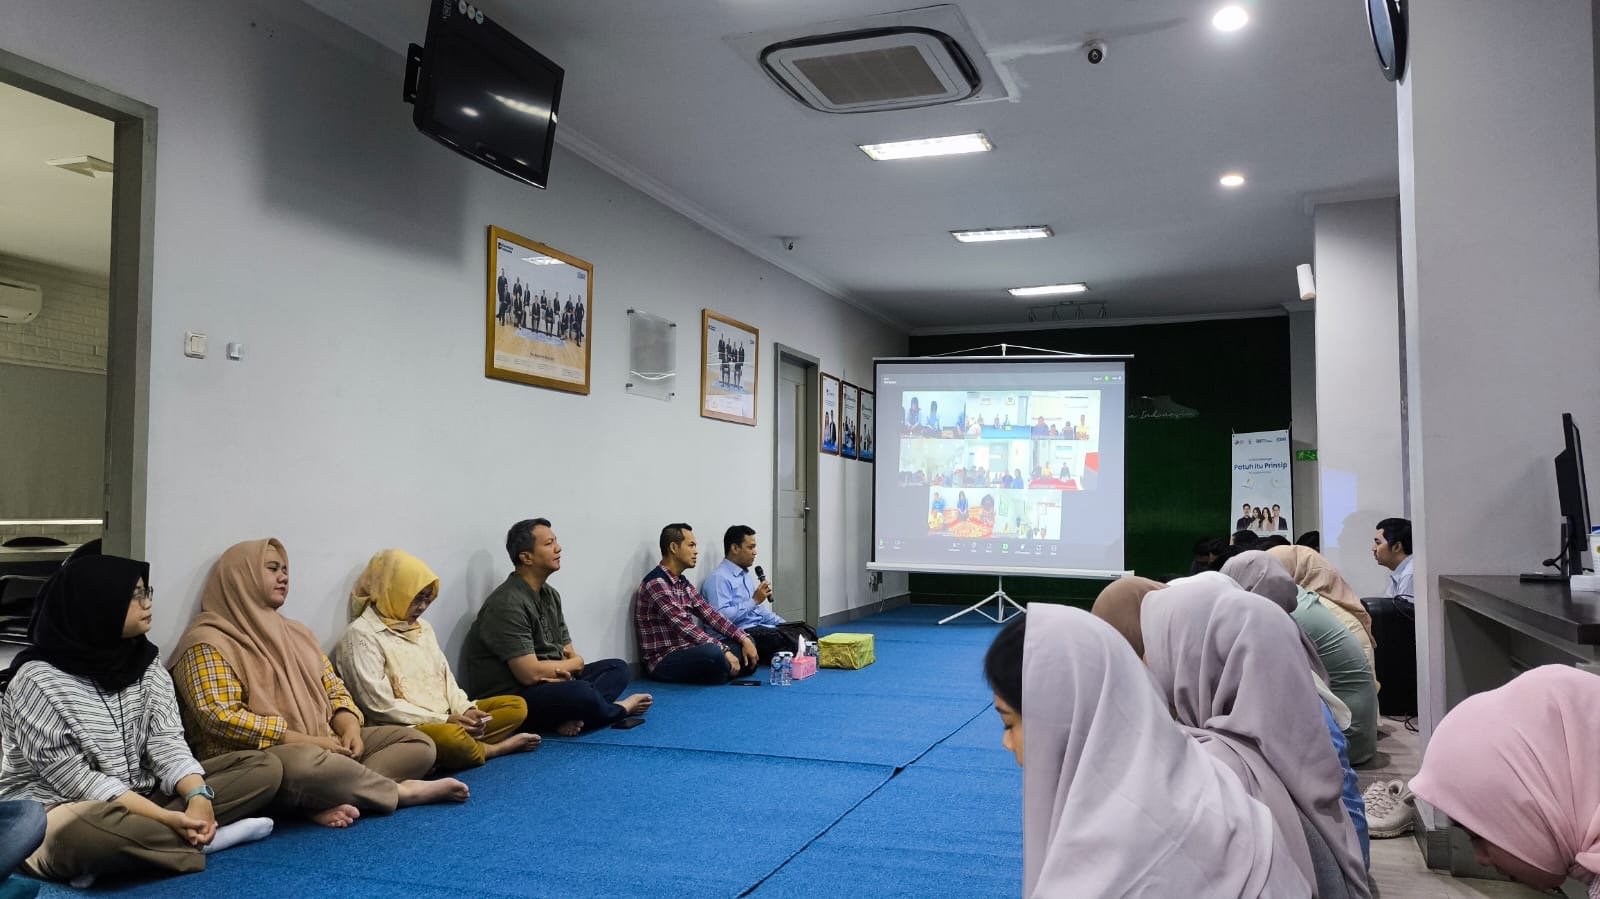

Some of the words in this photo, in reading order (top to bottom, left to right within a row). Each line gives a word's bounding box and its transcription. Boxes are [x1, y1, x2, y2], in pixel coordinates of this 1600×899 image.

[1233, 463, 1254, 471] Patuh
[1254, 462, 1264, 470] Itu
[1264, 460, 1288, 470] Prinsip
